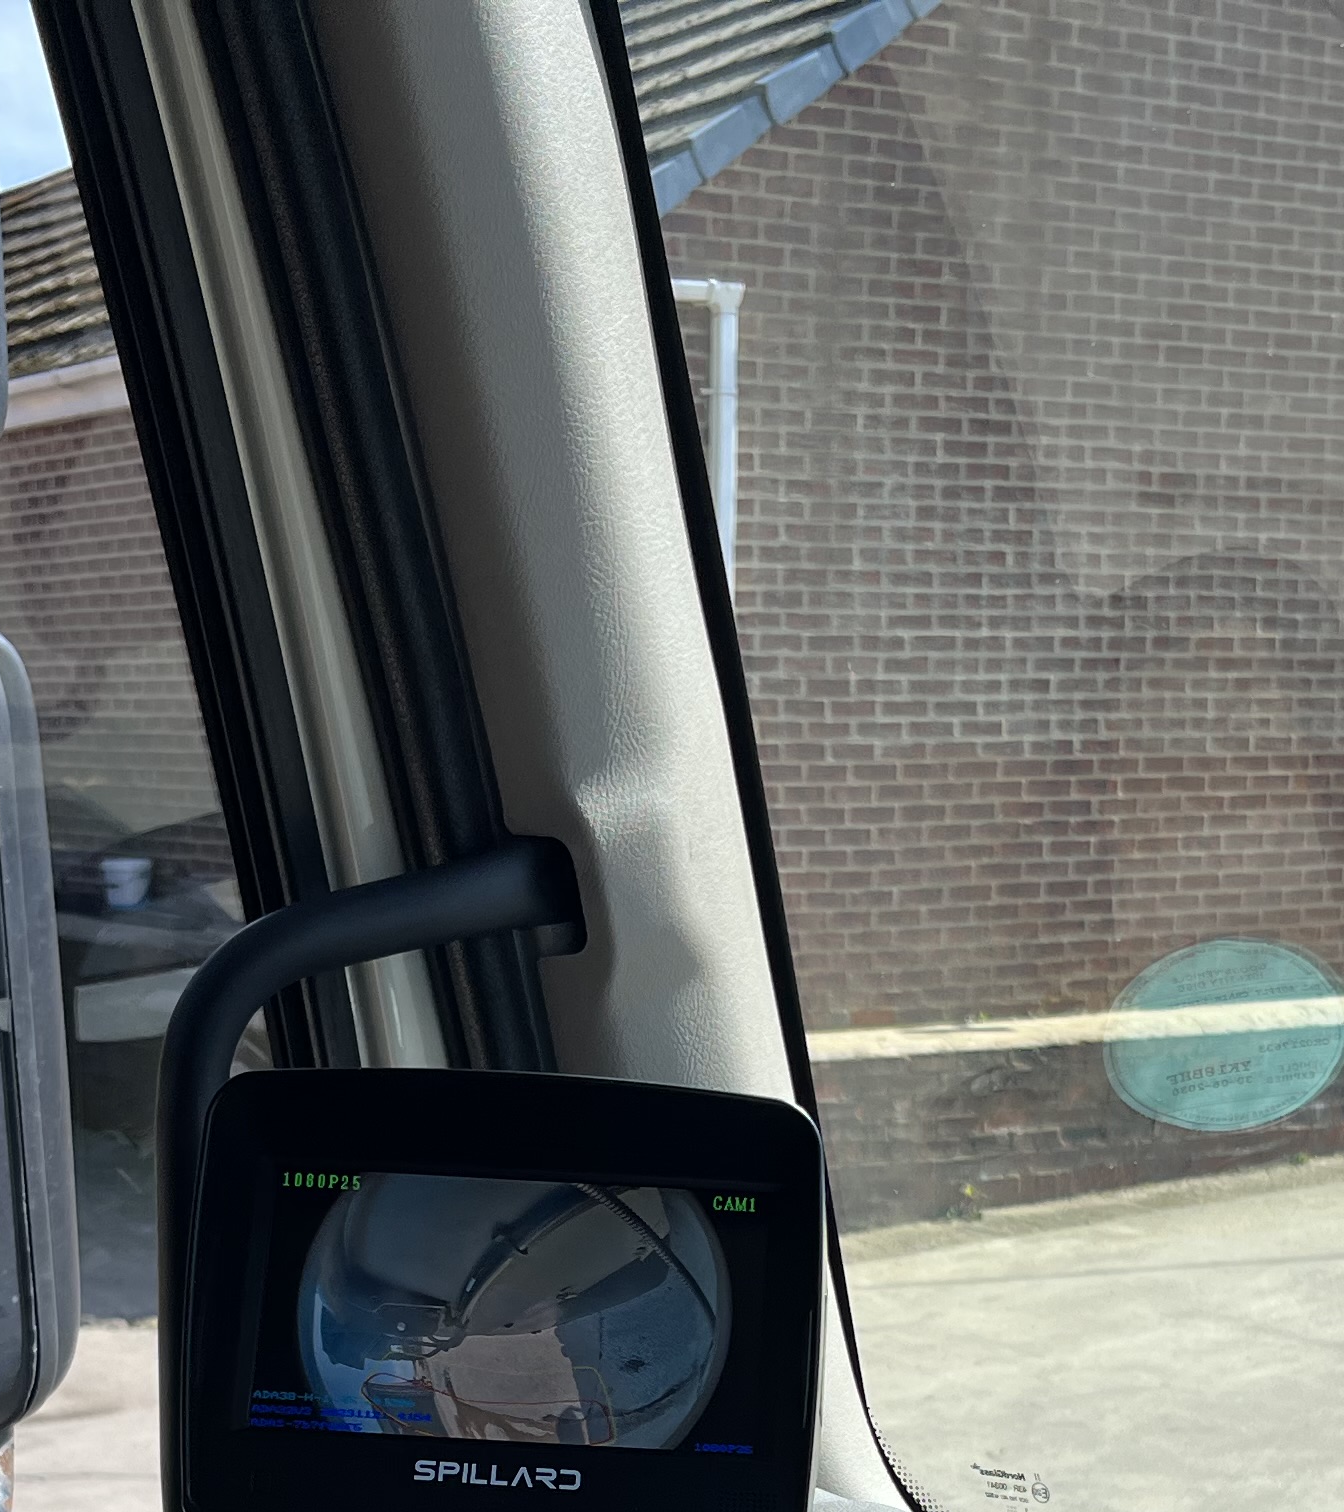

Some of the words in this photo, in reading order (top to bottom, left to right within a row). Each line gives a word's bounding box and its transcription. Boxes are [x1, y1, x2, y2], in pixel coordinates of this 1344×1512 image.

[282, 1171, 362, 1191] 1080P25
[712, 1195, 756, 1213] CAM1
[413, 1459, 582, 1491] SPILLARD
